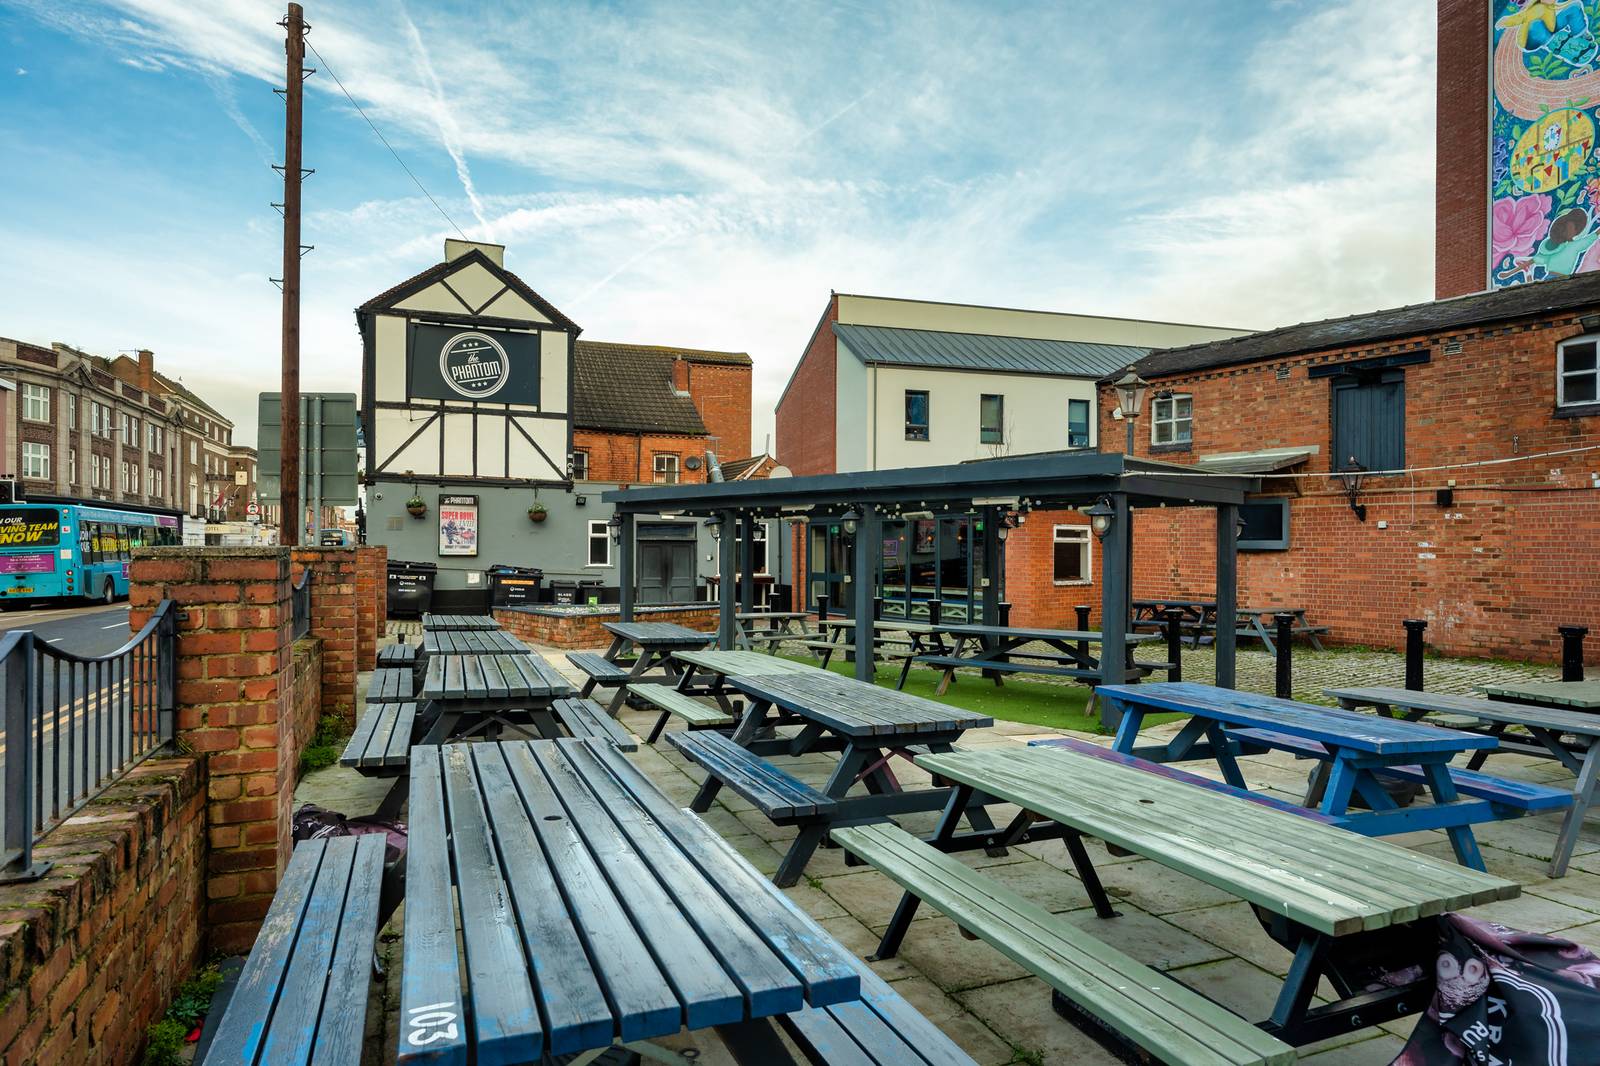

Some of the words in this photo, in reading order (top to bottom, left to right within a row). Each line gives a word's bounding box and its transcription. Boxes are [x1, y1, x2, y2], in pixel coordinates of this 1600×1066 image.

[451, 360, 501, 381] PHANTOM
[0, 525, 27, 533] VING
[29, 522, 58, 531] TEAM
[0, 531, 43, 544] NOW
[408, 1001, 458, 1046] 103
